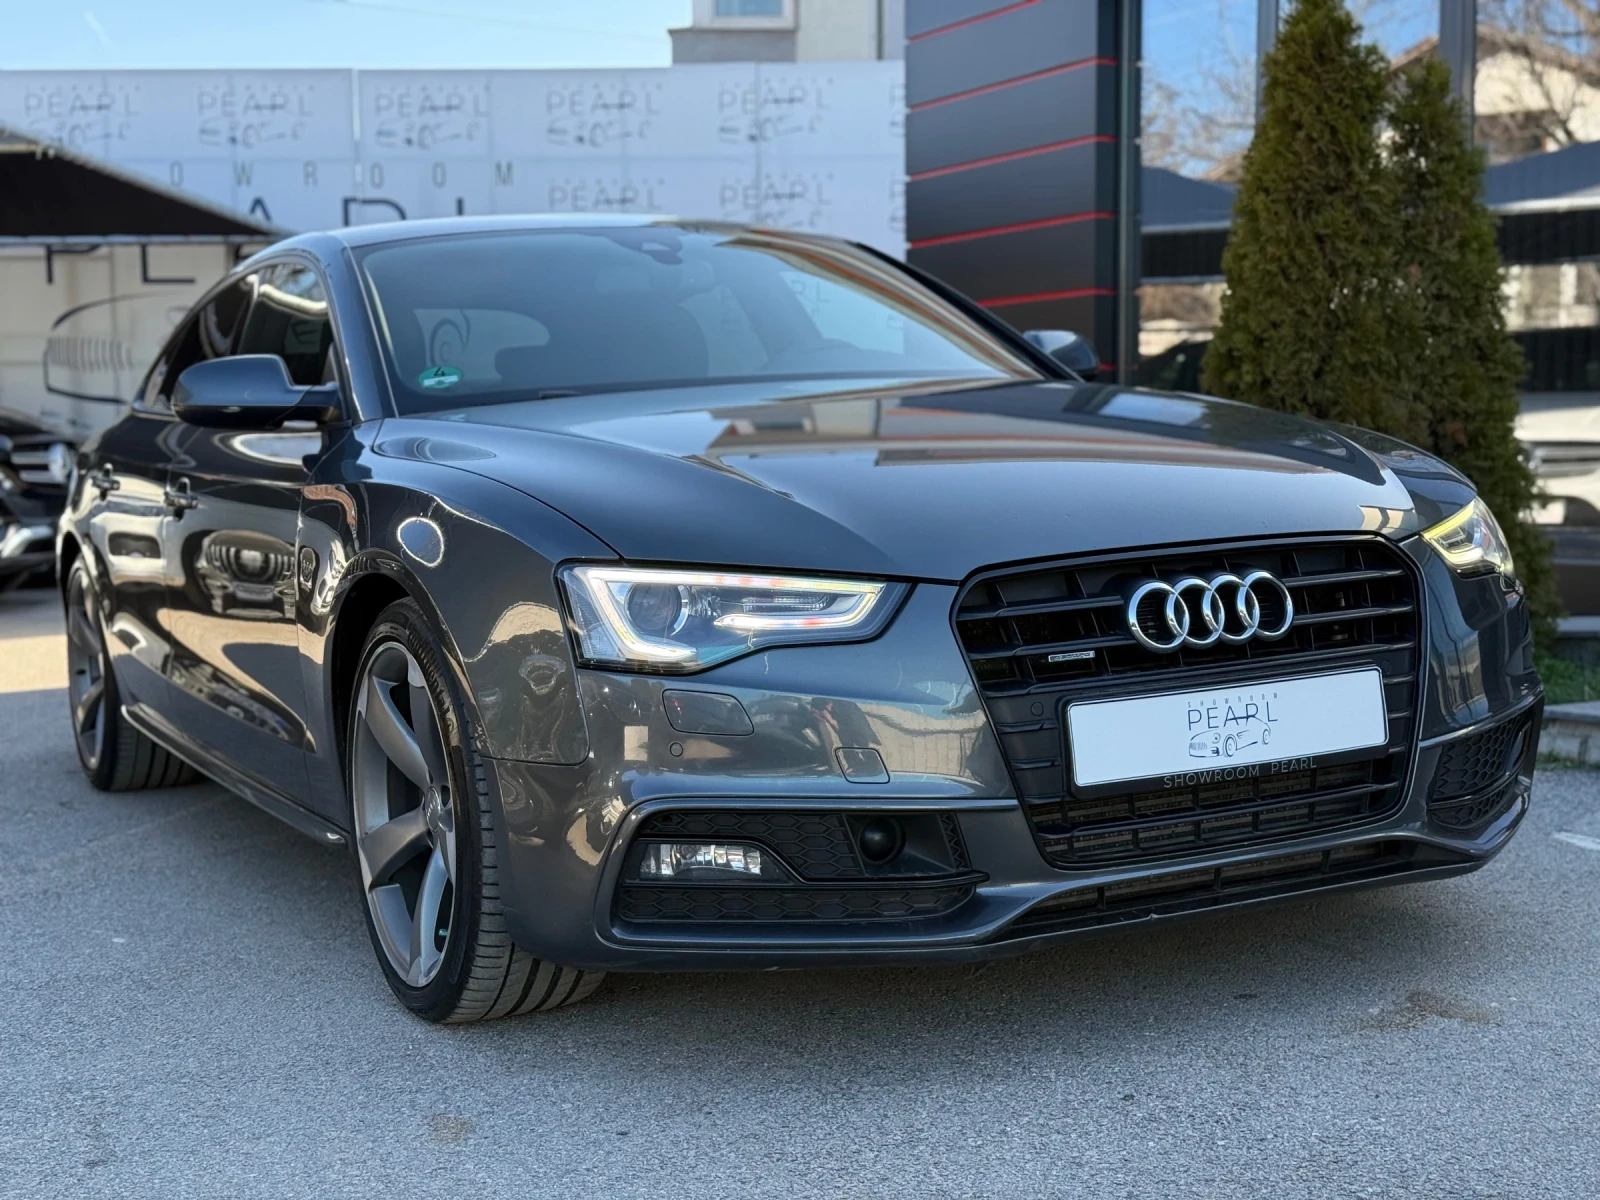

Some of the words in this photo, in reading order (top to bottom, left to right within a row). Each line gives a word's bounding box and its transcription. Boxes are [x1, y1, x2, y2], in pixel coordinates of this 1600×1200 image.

[24, 91, 139, 117] PEARL
[197, 90, 315, 117] PEARL
[374, 91, 489, 118] PEARL
[545, 89, 660, 116] PEARL
[547, 184, 663, 212] PEARL
[1187, 692, 1278, 708] SHOWROOM
[1187, 701, 1278, 731] PEARL
[1163, 765, 1260, 788] SHOWROOM
[1271, 756, 1317, 774] PEARL
